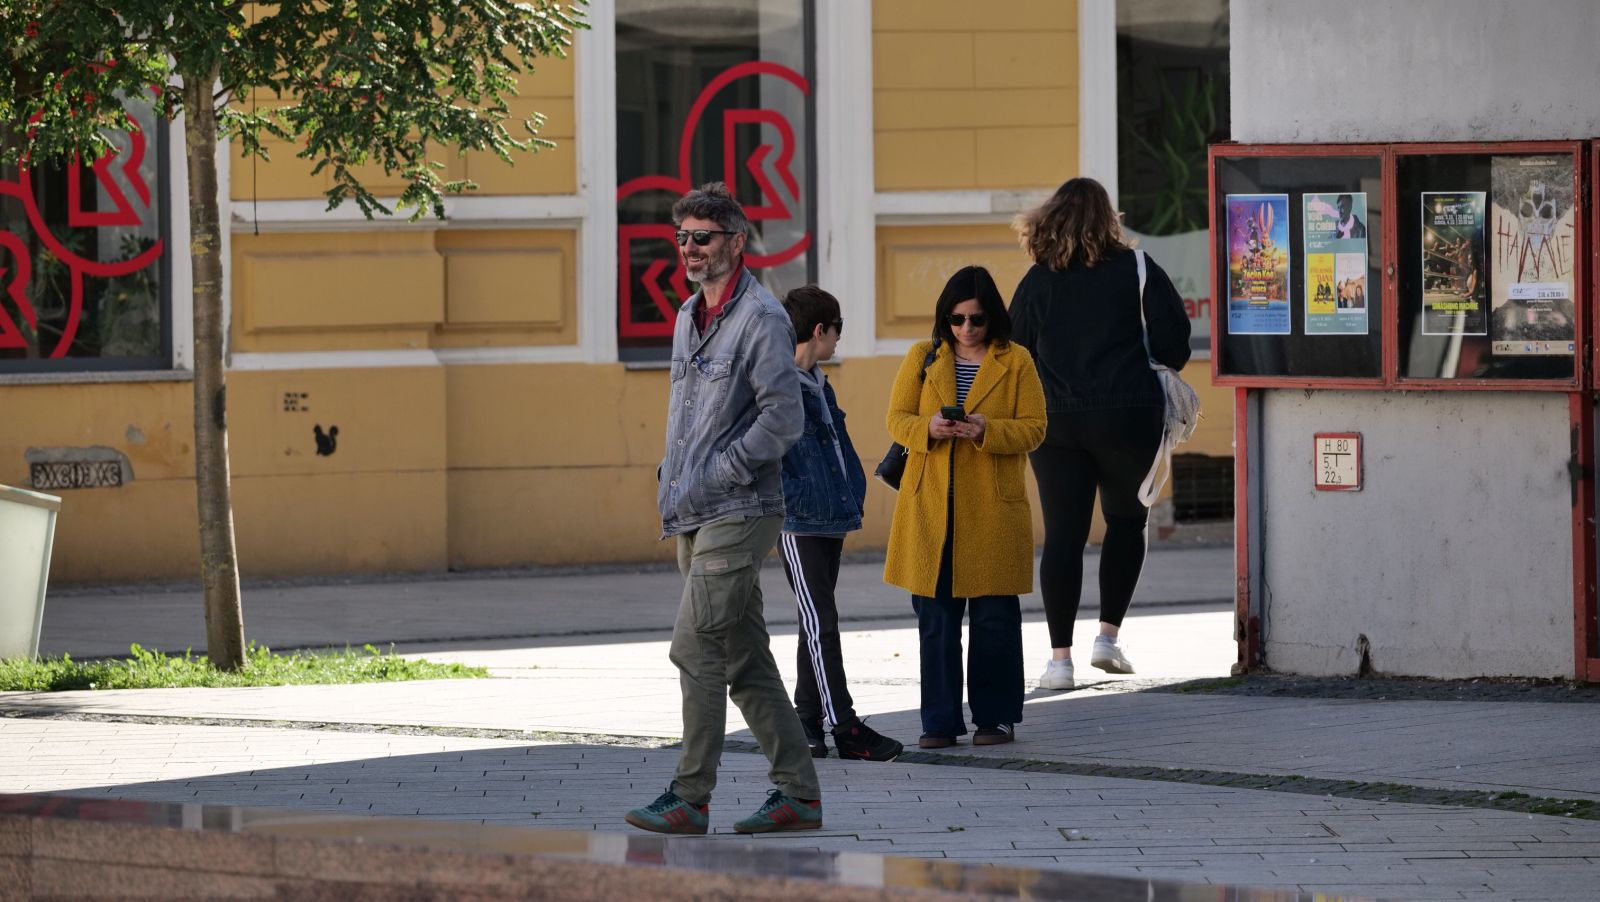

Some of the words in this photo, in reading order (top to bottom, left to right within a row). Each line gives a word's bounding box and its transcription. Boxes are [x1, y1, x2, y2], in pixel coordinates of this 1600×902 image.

[1496, 215, 1574, 284] HAMLE
[1325, 439, 1331, 452] H
[1337, 439, 1349, 452] 80
